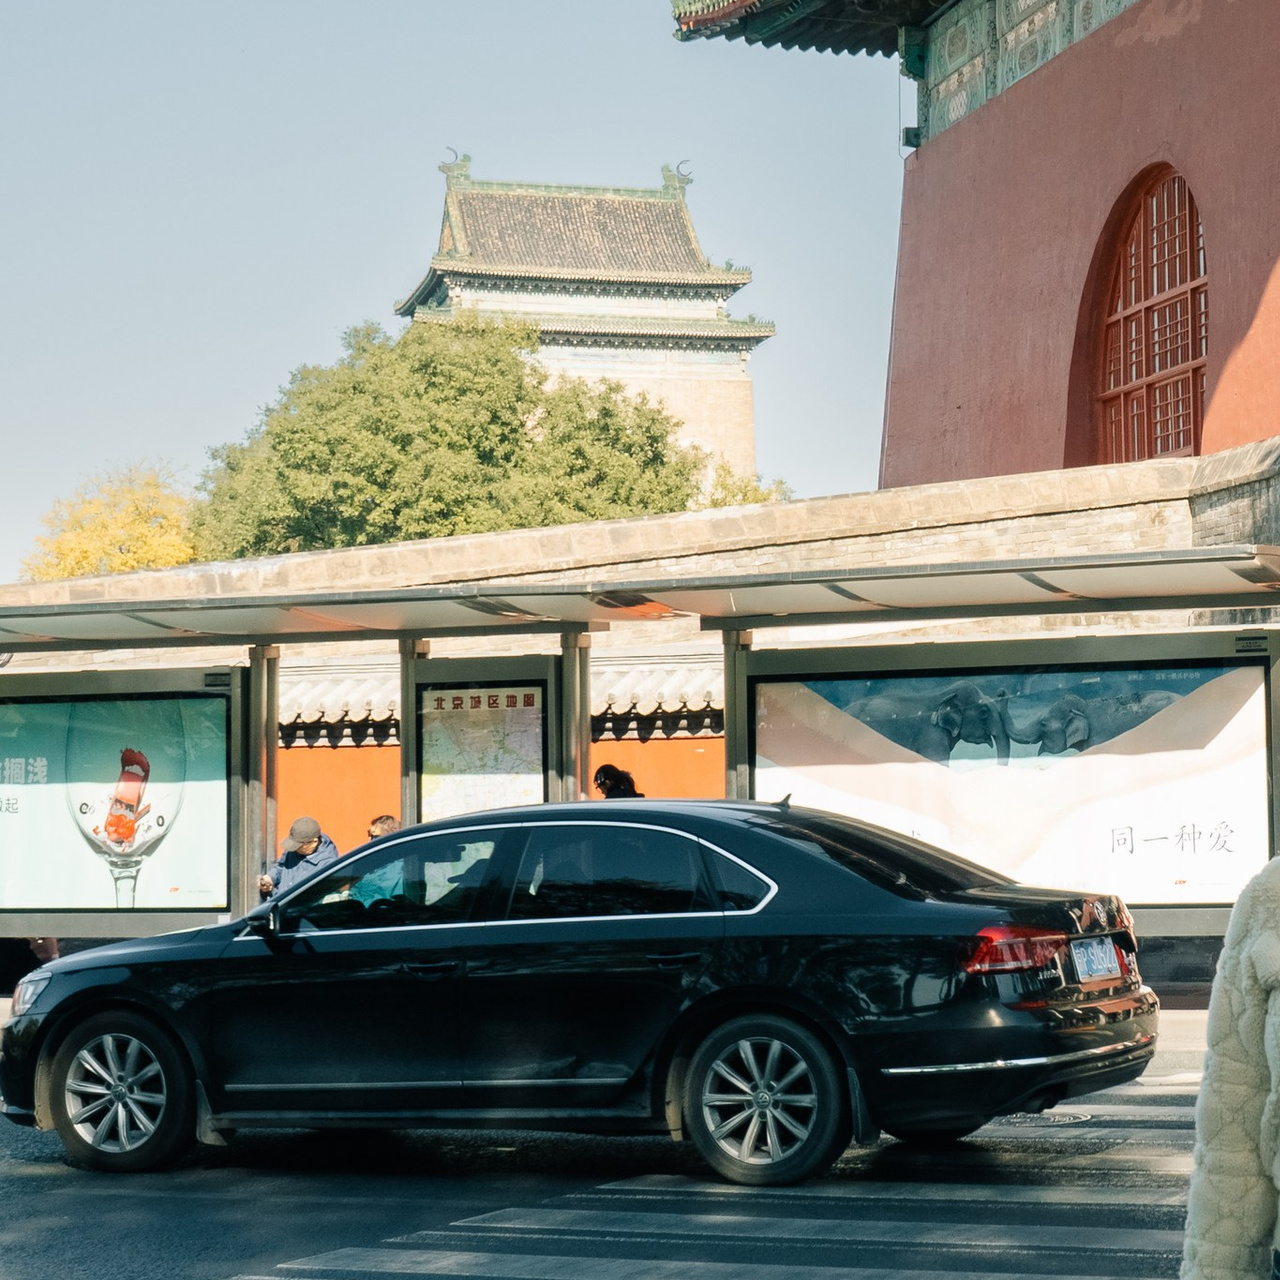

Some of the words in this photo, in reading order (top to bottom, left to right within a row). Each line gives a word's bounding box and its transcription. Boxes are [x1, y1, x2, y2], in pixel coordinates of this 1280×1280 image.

[433, 693, 535, 710] 北京城区地图
[0, 756, 48, 785] 搁浅
[1111, 821, 1236, 855] 同一种爱
